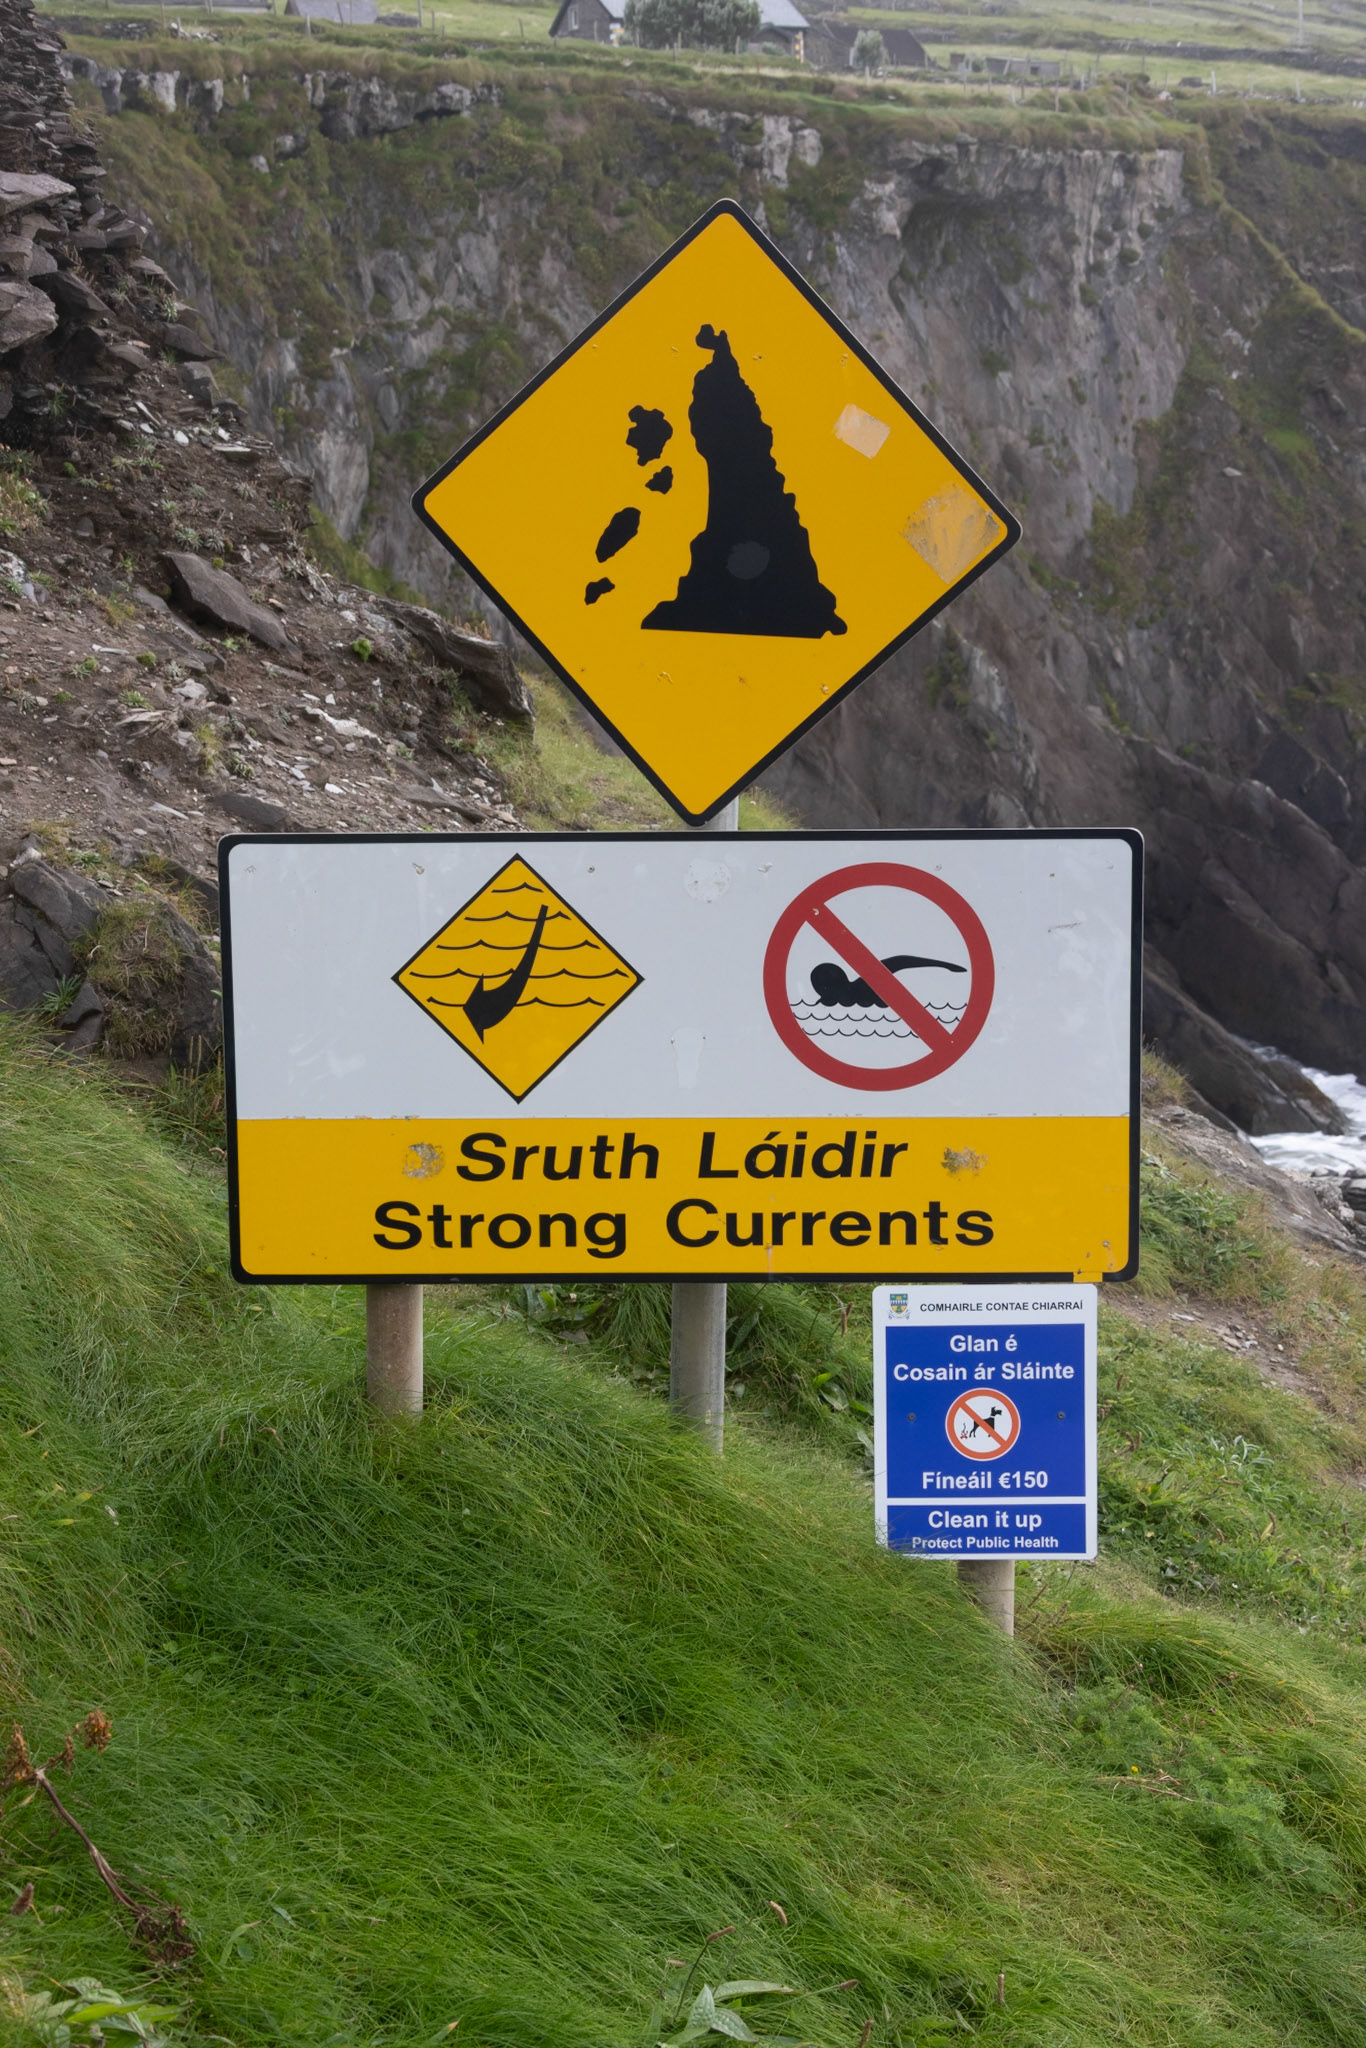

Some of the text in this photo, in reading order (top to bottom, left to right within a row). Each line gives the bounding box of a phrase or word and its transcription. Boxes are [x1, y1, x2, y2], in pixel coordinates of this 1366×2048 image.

[456, 1130, 909, 1182] Sruth Láidir
[373, 1198, 994, 1259] Strong Currents
[920, 1300, 1083, 1312] COMHAIRLE CONTAE CHIARRAÍ
[950, 1334, 1018, 1353] Glan é
[893, 1362, 1075, 1381] Cosain ár Sláinte
[922, 1470, 1048, 1489] Fíneáil €150
[928, 1510, 1042, 1532] Clean it up
[912, 1536, 1059, 1549] Protect Public Health
